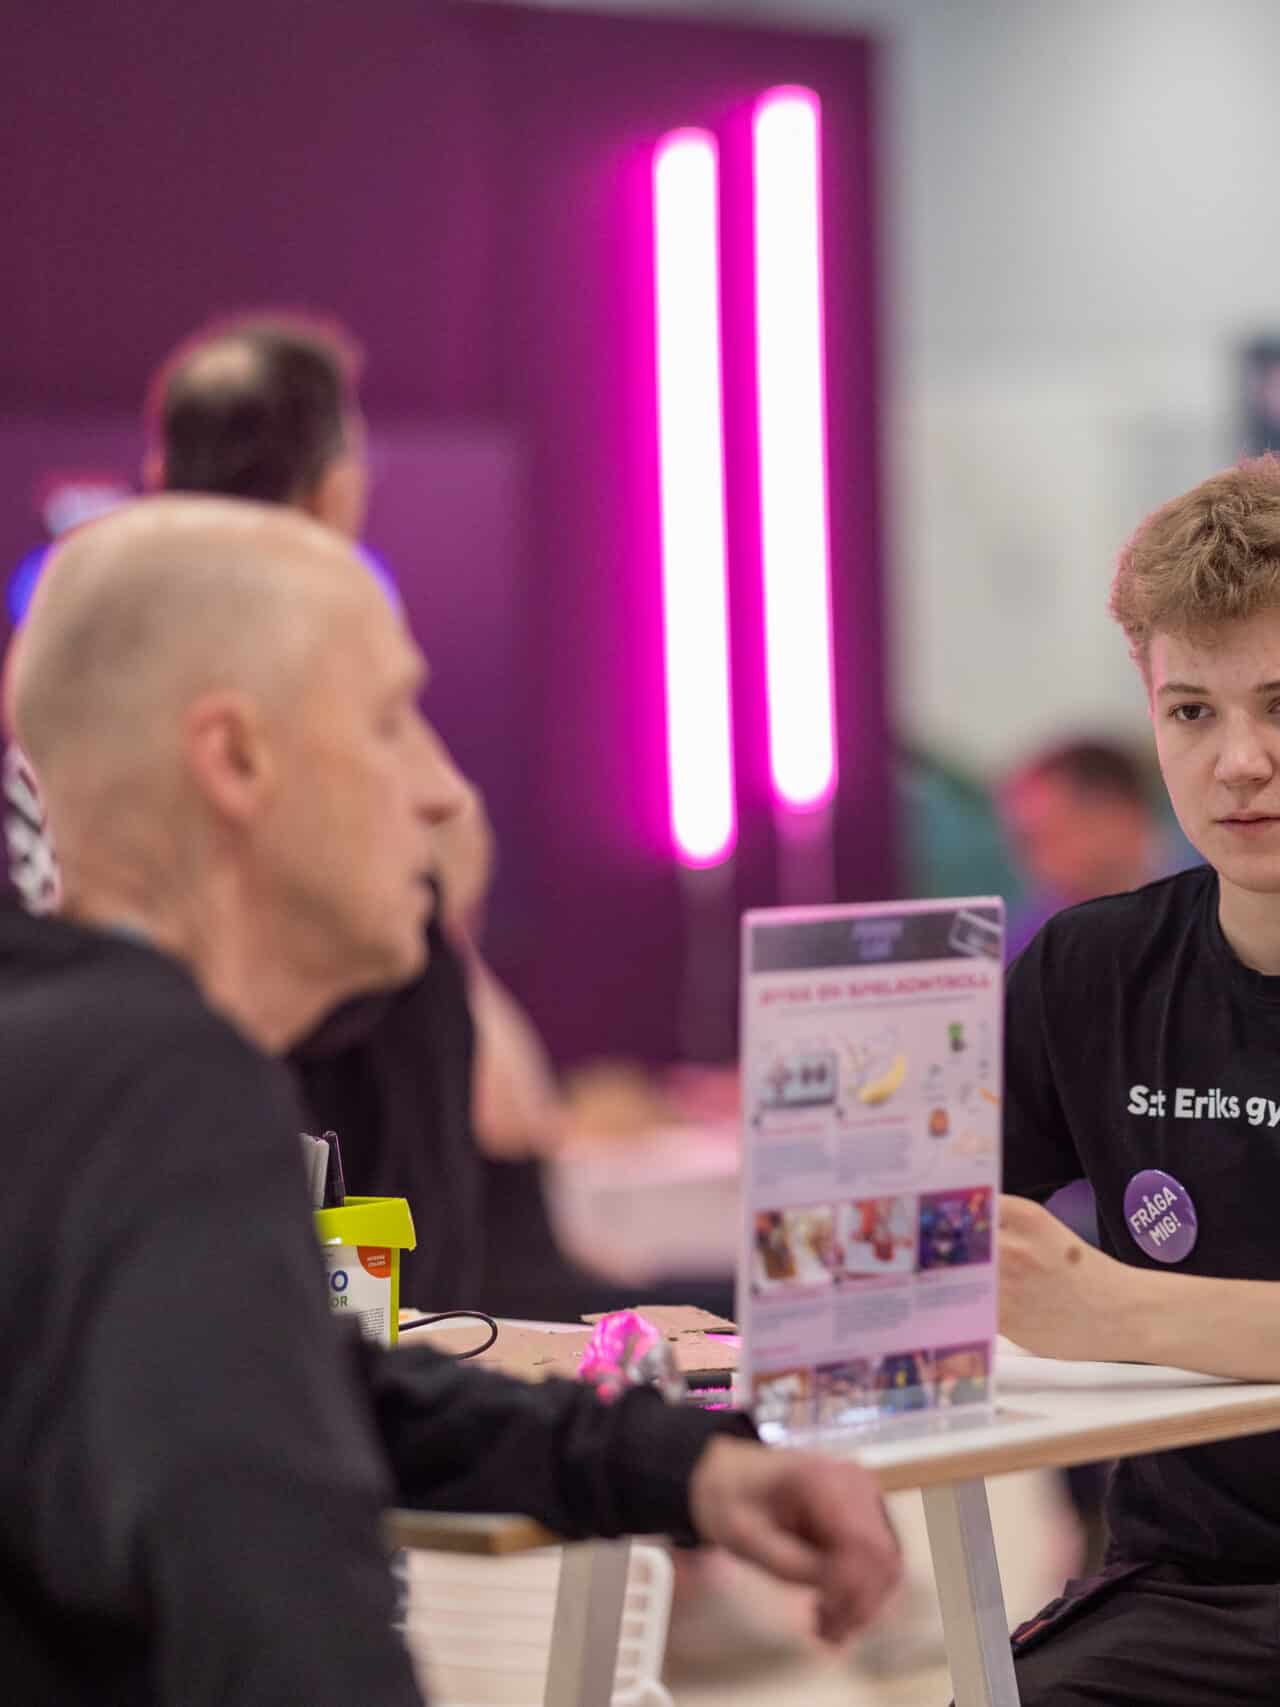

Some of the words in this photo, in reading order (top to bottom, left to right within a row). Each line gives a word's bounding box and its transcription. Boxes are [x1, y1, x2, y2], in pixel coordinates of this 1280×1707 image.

[1127, 1085, 1166, 1117] S:t
[1174, 1088, 1241, 1119] Eriks
[1130, 1187, 1178, 1234] FRÅGA
[1149, 1211, 1182, 1246] MIG!
